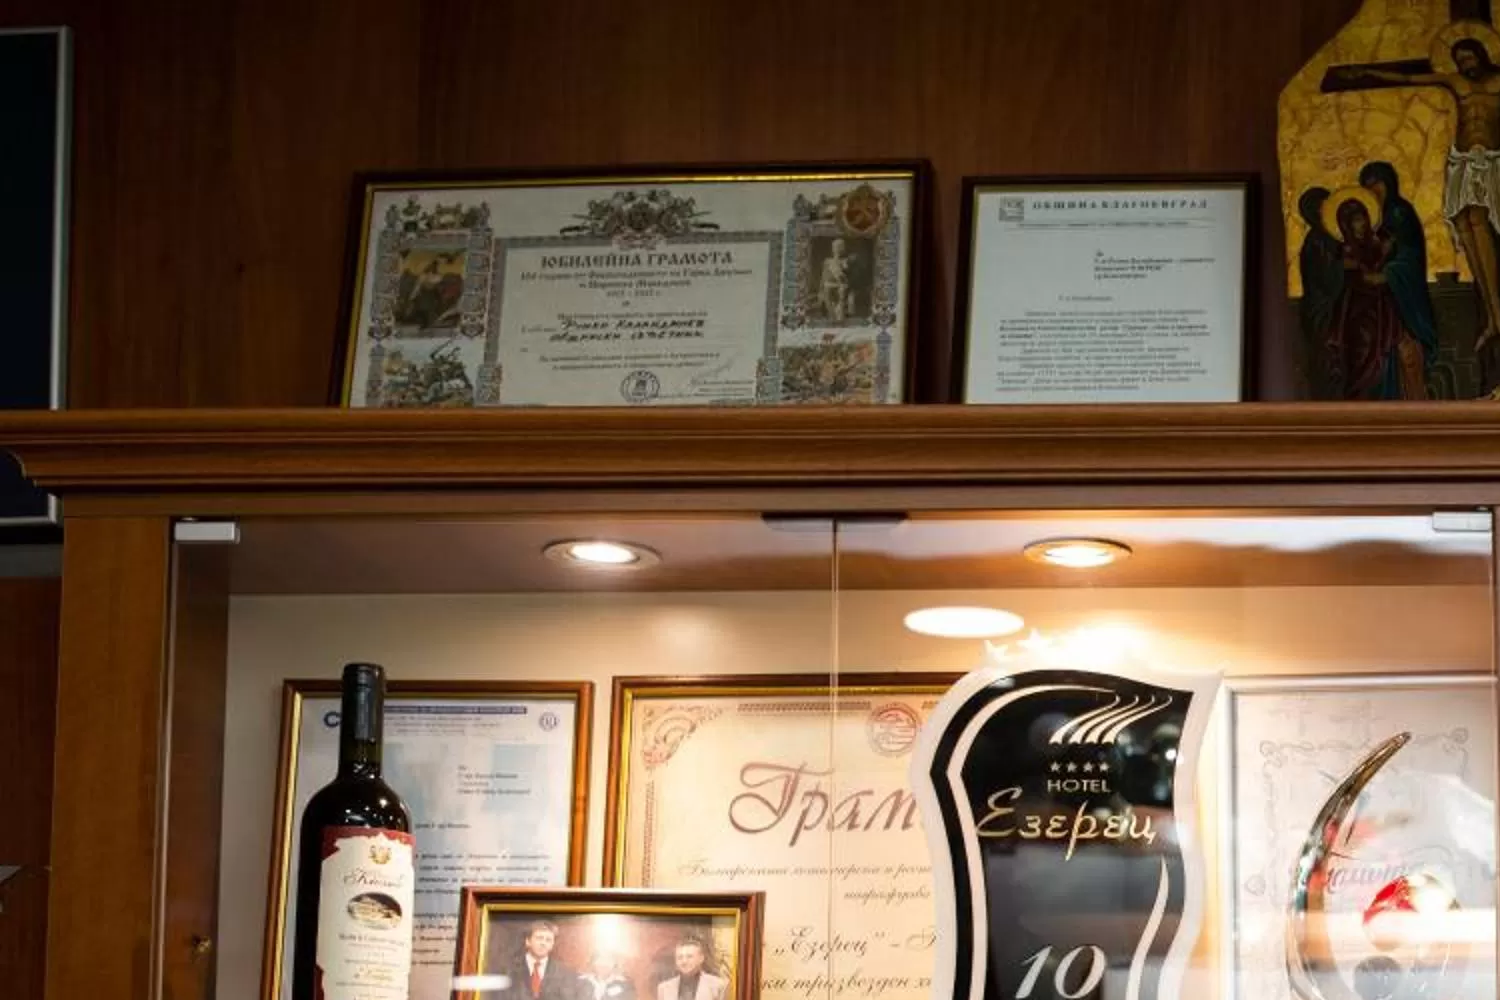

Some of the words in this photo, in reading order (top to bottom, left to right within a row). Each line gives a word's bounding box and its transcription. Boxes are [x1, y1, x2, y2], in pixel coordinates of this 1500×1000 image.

[648, 251, 733, 267] ГРАМОТА
[728, 761, 918, 848] Грам
[1046, 778, 1112, 793] HOTEL
[975, 786, 1157, 861] Езерец
[1015, 945, 1107, 1000] 10
